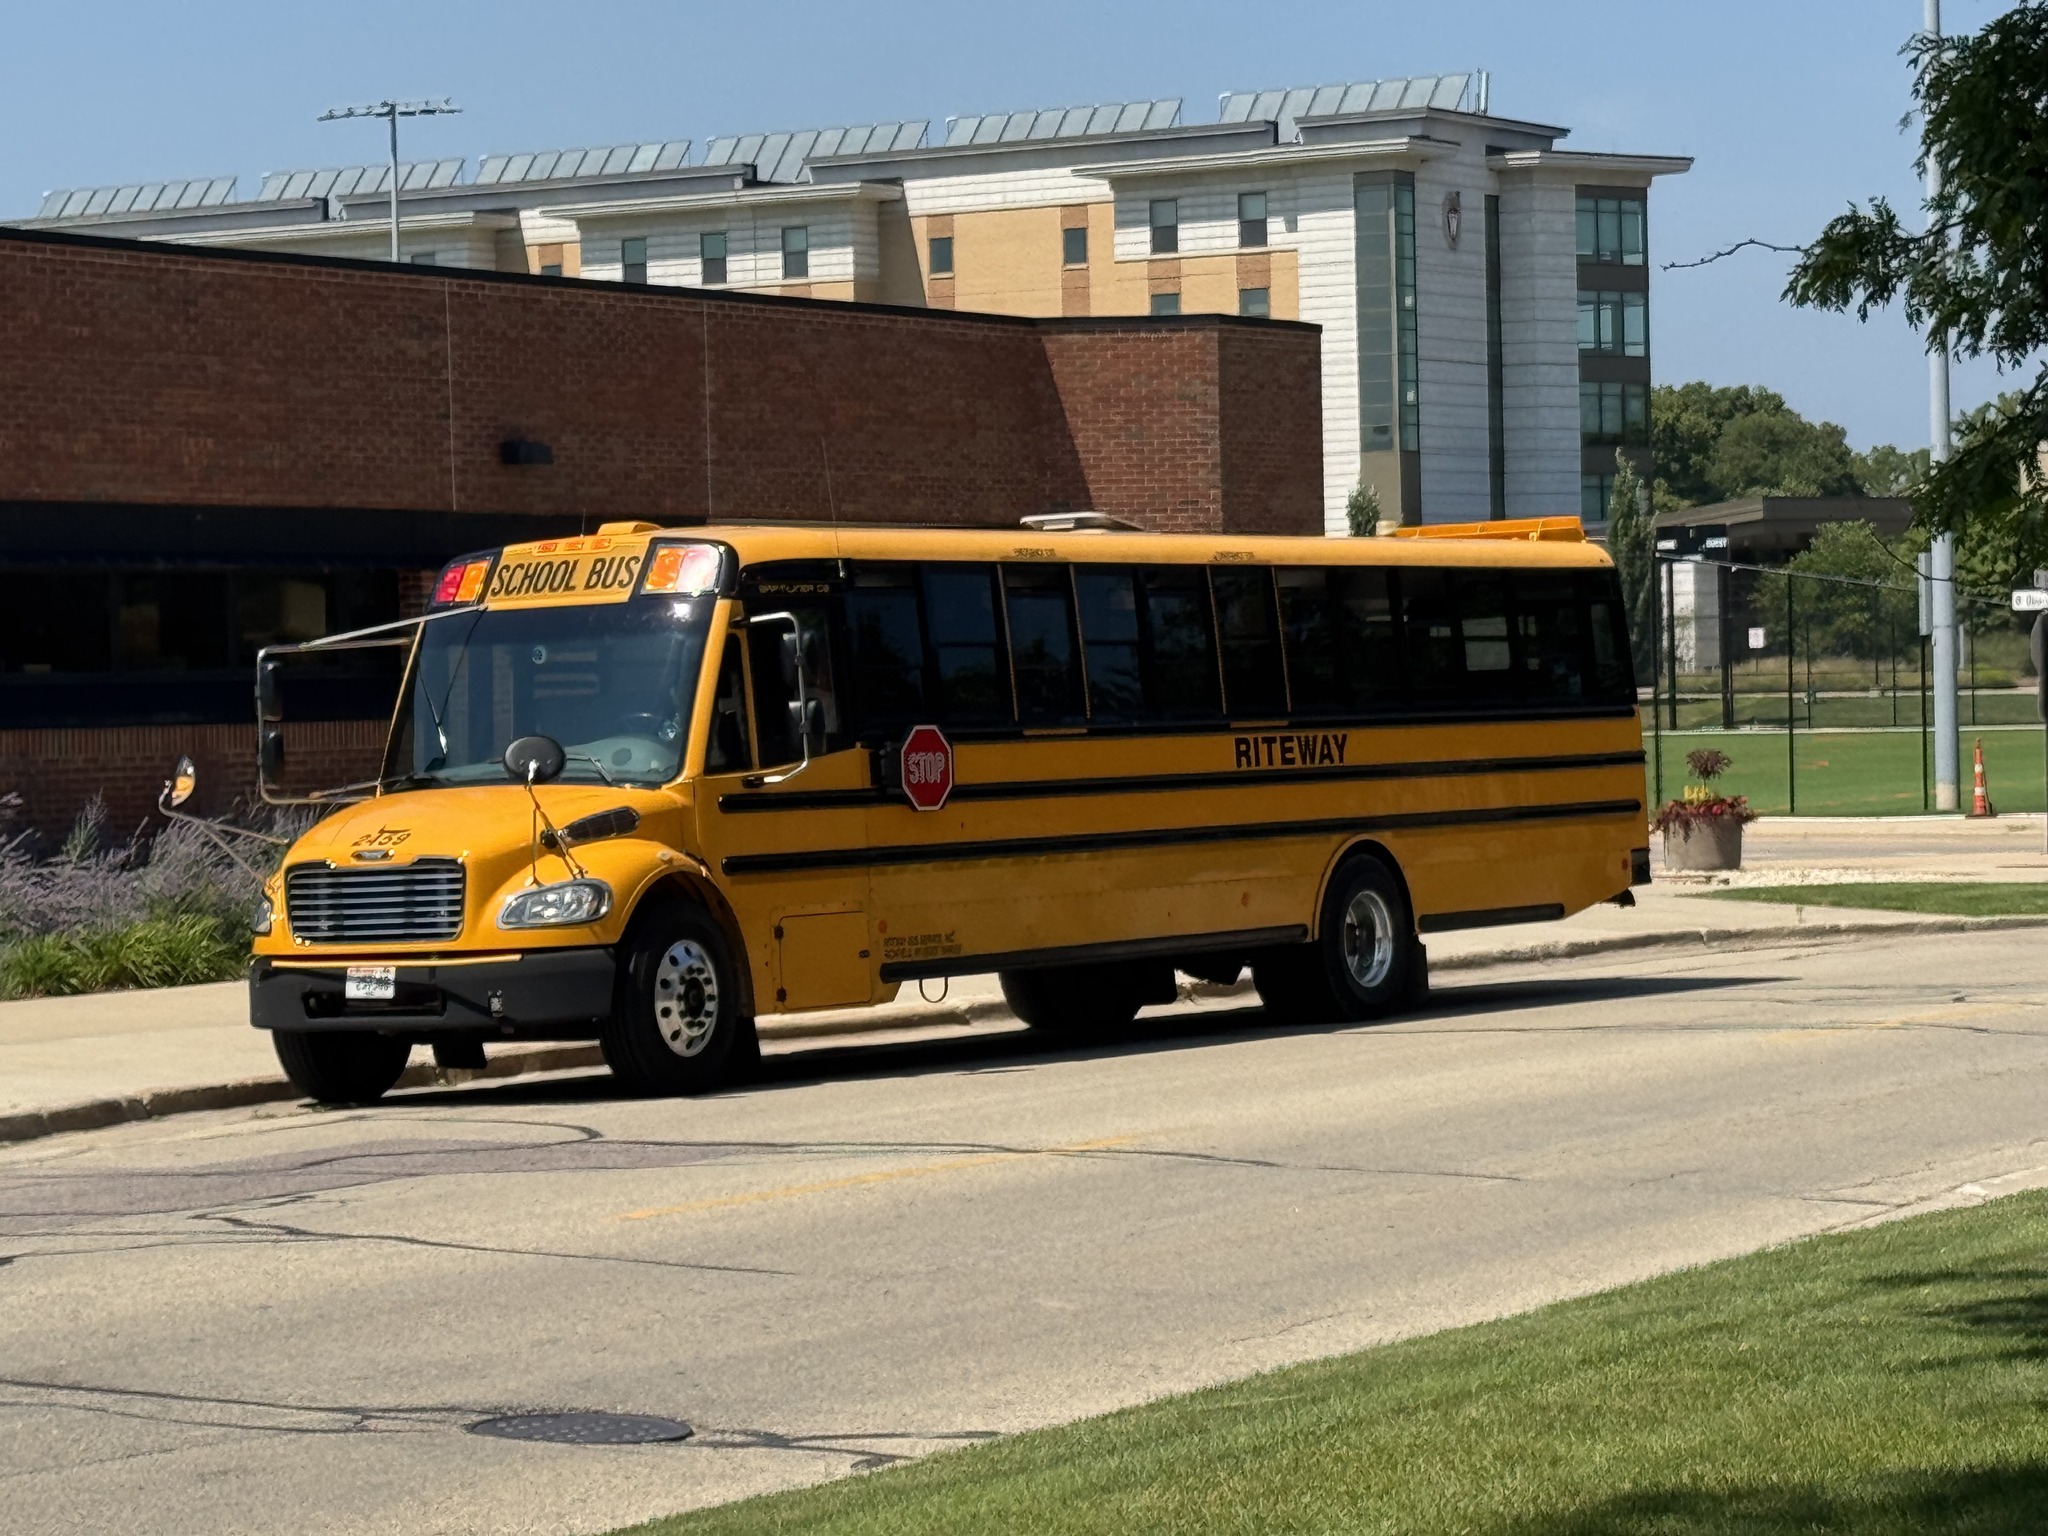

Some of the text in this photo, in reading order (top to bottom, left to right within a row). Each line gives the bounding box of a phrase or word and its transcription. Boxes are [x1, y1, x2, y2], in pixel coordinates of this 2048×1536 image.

[491, 555, 641, 598] SCHOOL BUS
[908, 751, 945, 784] STOP
[1234, 733, 1348, 769] RITEWAY
